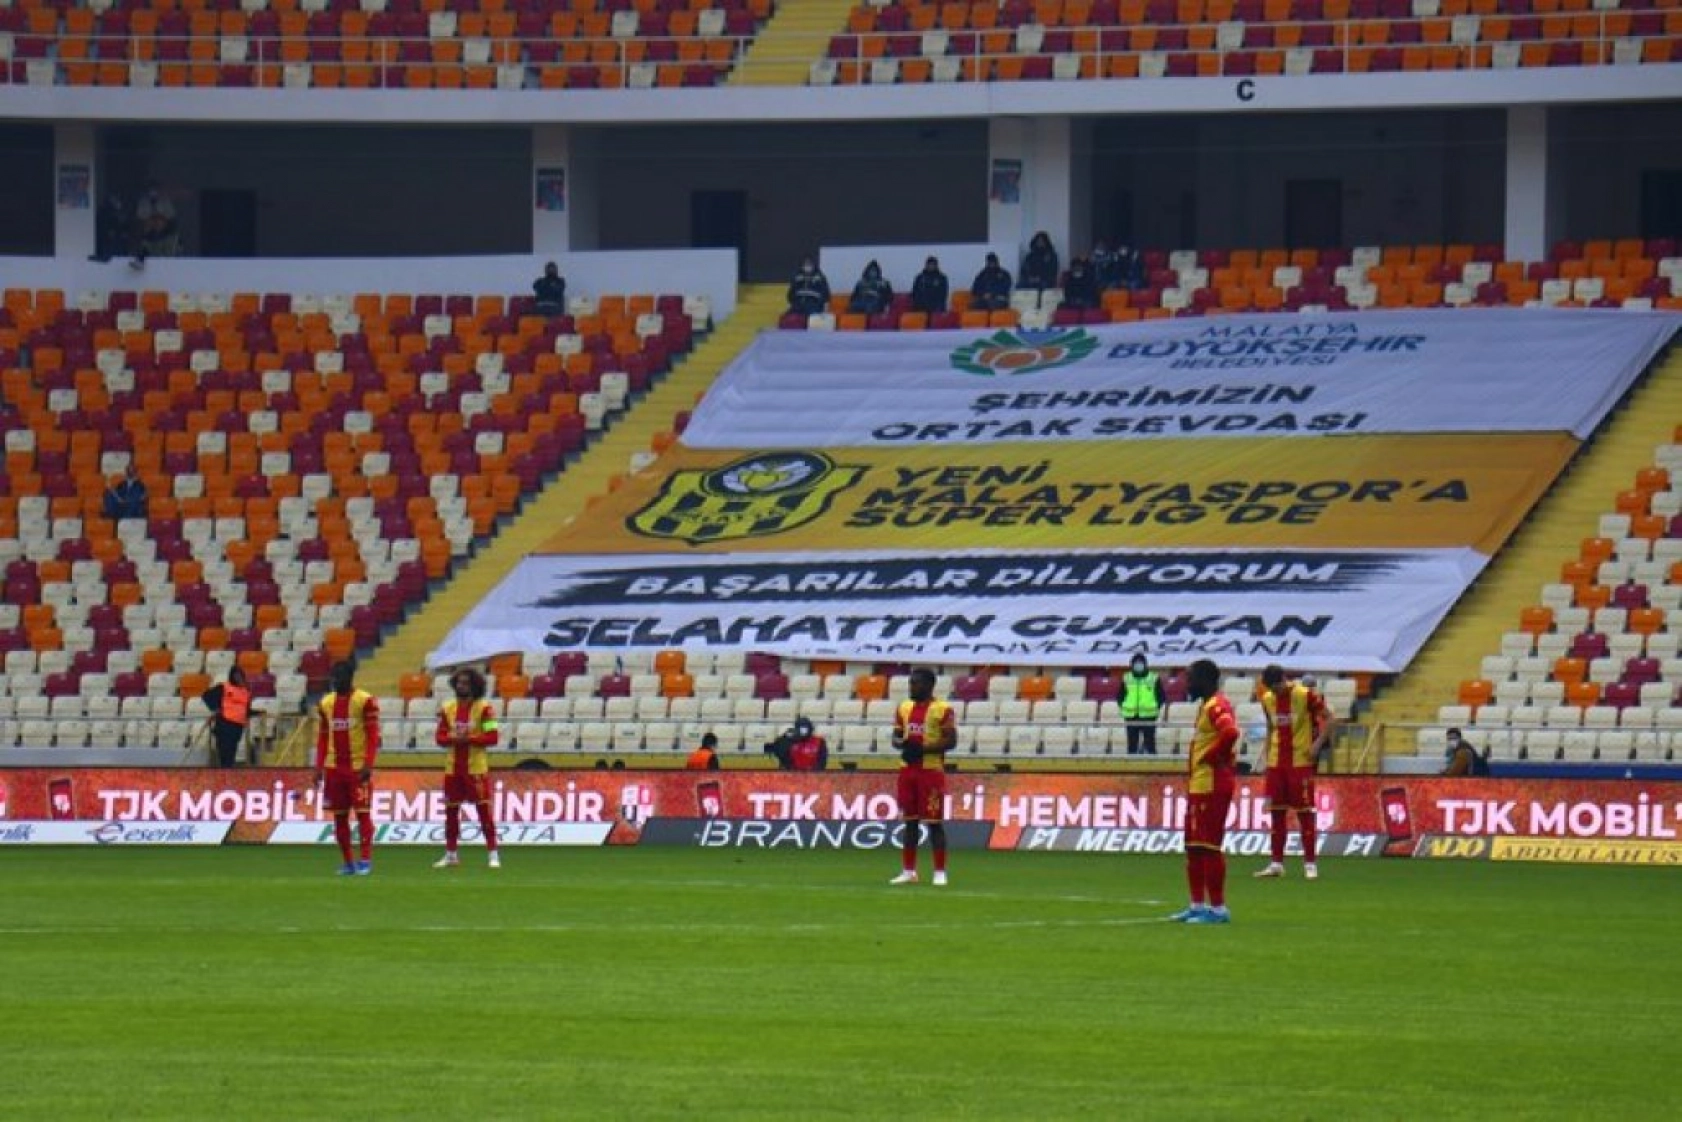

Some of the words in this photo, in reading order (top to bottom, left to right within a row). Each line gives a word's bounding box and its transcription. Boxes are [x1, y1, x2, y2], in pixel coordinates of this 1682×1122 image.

[1236, 79, 1256, 102] C
[1199, 322, 1358, 338] MALATYA
[871, 418, 1083, 440] ORTAK
[895, 460, 1051, 487] YENİ
[624, 567, 980, 598] BAŞARILAR
[986, 562, 1341, 588] DİLİYORUM
[97, 789, 169, 821] TJK
[493, 780, 605, 822] İNDİR
[748, 793, 820, 820] TJK
[830, 784, 985, 821] MOL'İ
[1000, 794, 1148, 828] HEMEN
[1436, 799, 1518, 835] TJK
[699, 819, 928, 849] BRANGO
[1076, 828, 1185, 853] MERCA
